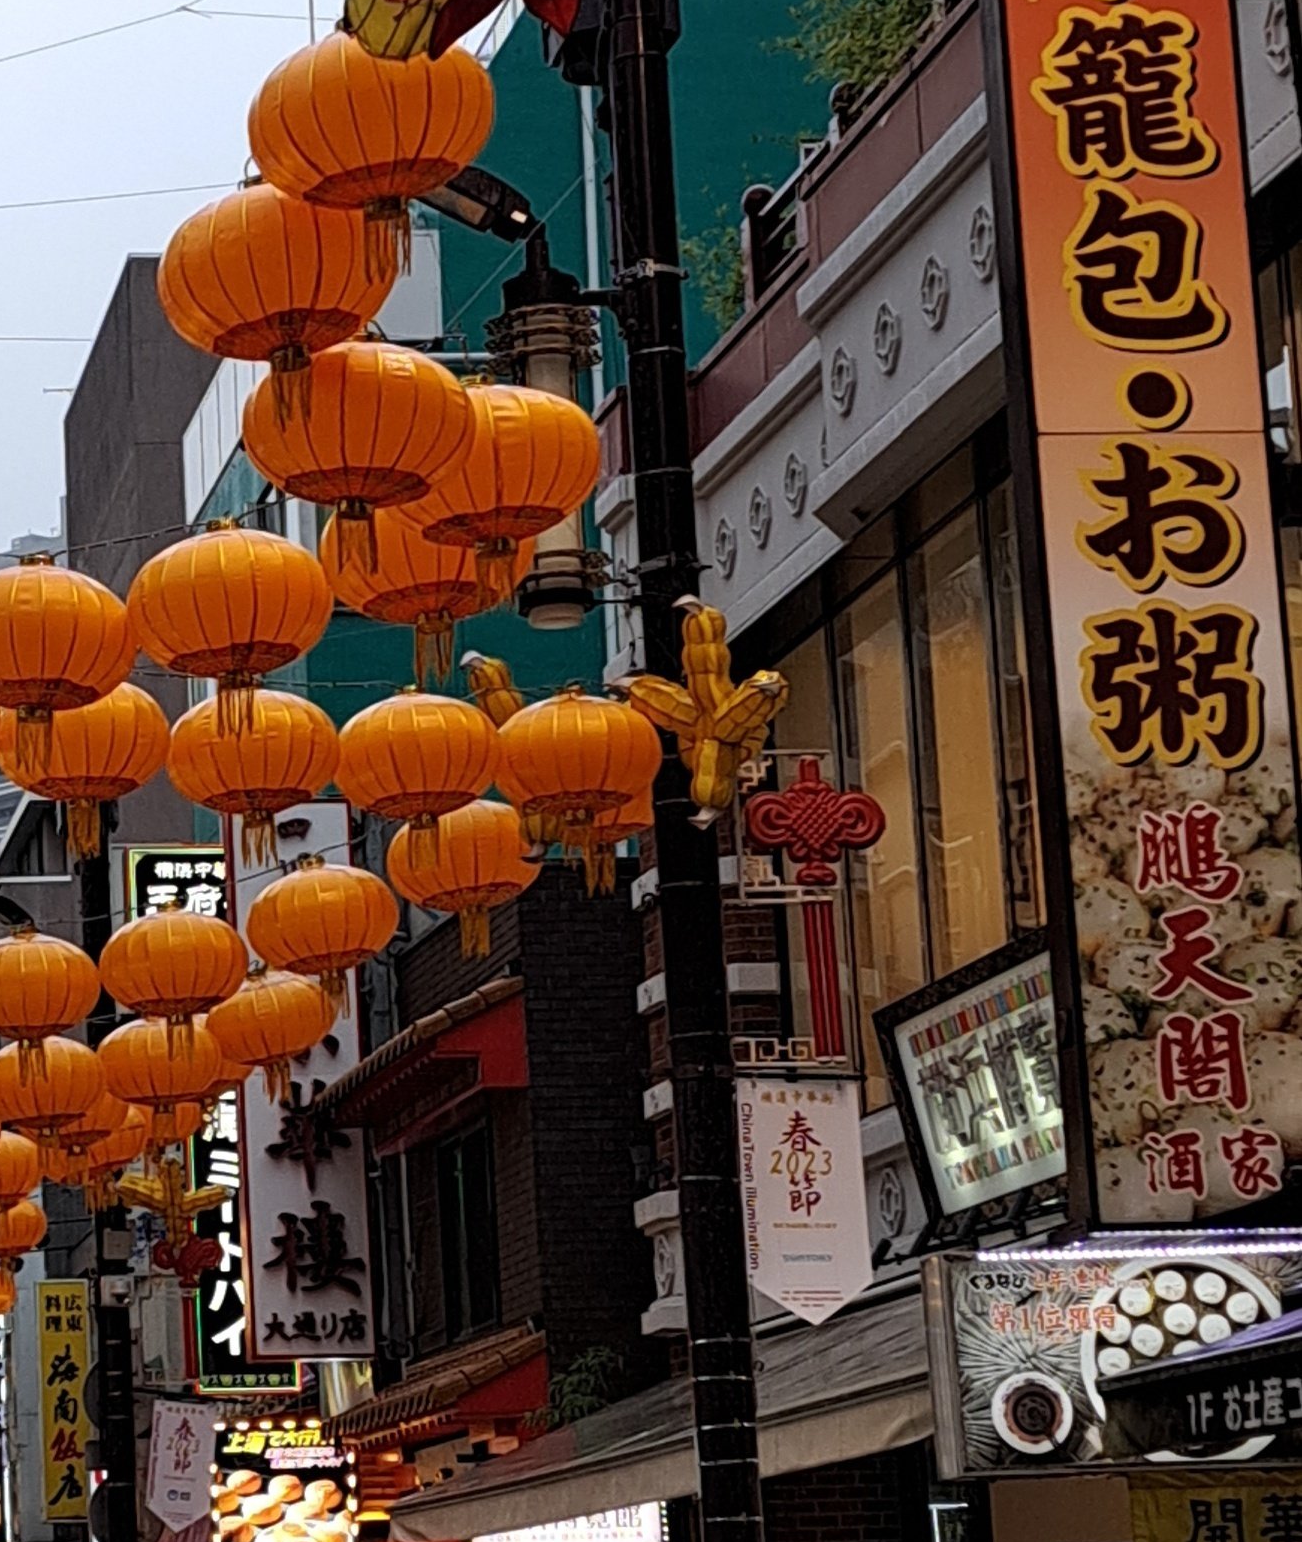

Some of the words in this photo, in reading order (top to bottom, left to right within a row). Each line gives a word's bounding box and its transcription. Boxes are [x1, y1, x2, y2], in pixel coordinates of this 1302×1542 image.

[1135, 800, 1255, 1115] 鵬天閣
[770, 1150, 833, 1176] 2023
[1145, 1128, 1285, 1202] 酒家
[262, 1313, 368, 1344] 大通り店
